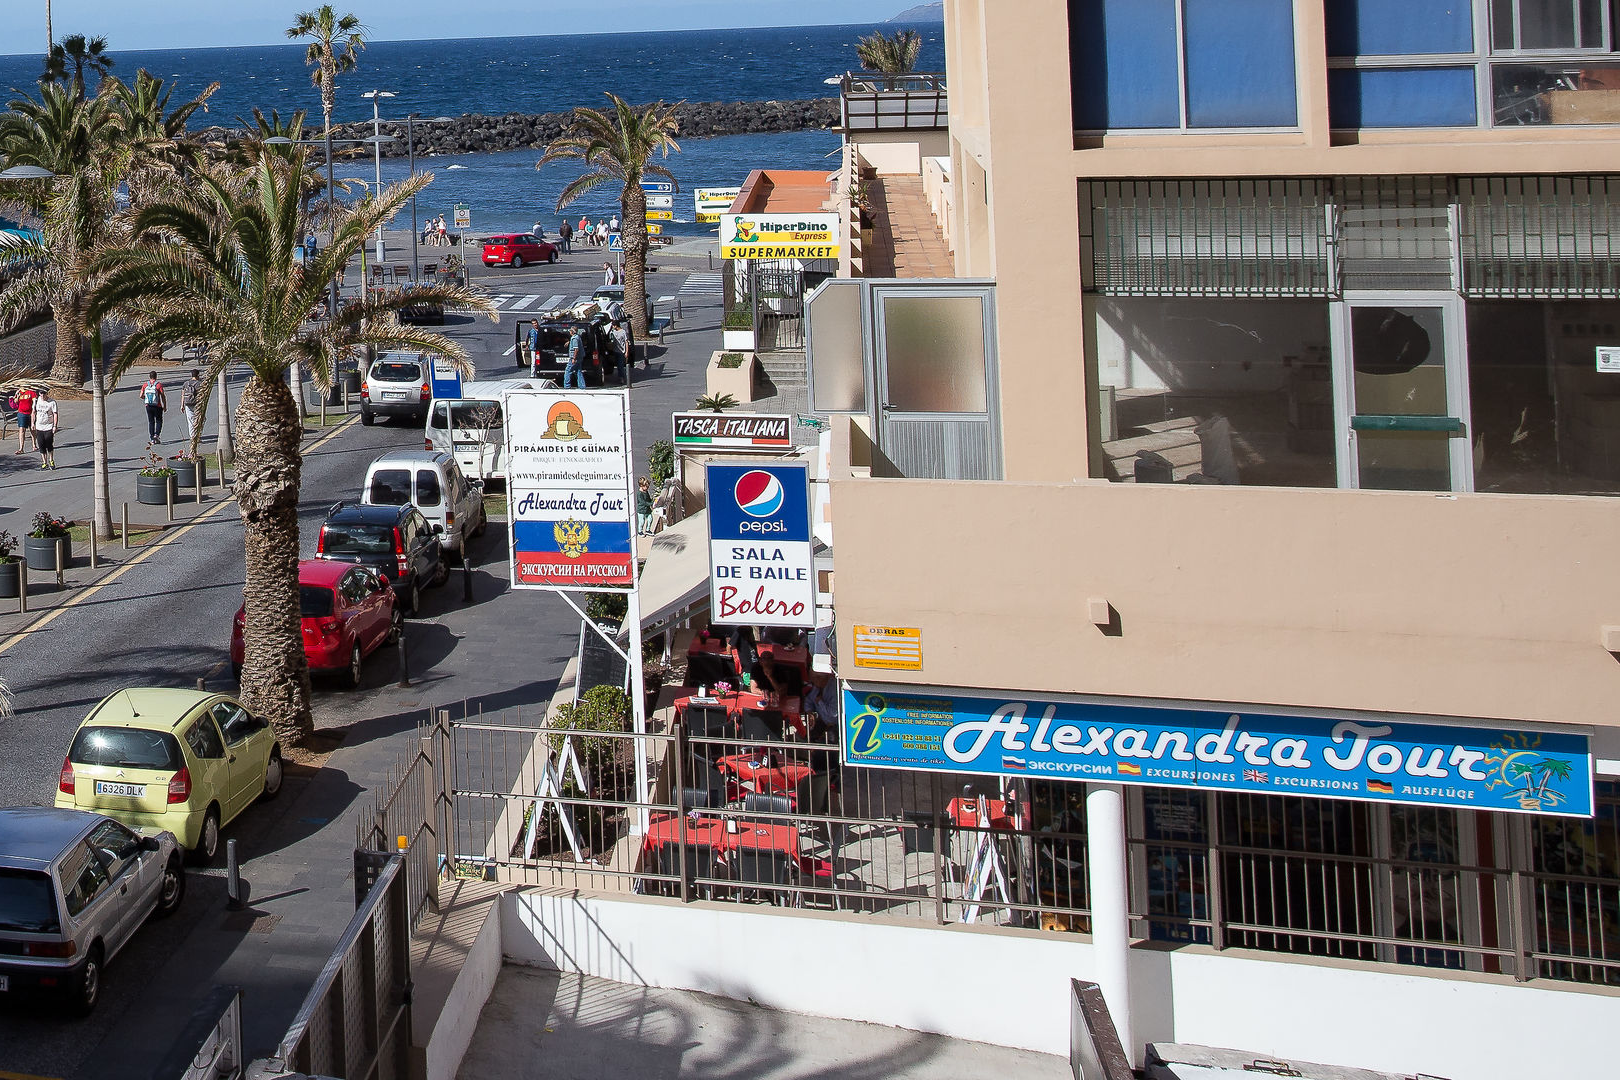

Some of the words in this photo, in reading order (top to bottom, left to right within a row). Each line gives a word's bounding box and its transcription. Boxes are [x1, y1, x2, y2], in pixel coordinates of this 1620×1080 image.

[760, 222, 828, 233] HiperDino
[794, 232, 828, 242] Express
[729, 246, 833, 258] SUPERMARKET
[677, 418, 718, 435] TASCA
[723, 419, 786, 437] ITALIANA
[514, 443, 564, 453] PIRÁMIDES
[567, 445, 579, 453] DE
[581, 443, 620, 453] GÜÍMAR
[516, 471, 622, 482] www.piramidesdeguimar.es
[518, 492, 587, 515] Alexandra
[590, 493, 623, 516] Tour
[739, 520, 784, 534] pepsi
[732, 547, 785, 561] SALA
[521, 563, 572, 576] ЭКСКУРСИИ
[573, 564, 585, 576] НА
[587, 565, 628, 577] РУССКОМ
[716, 565, 742, 579] DE
[749, 566, 807, 581] BAILE
[718, 585, 805, 618] Bolero
[942, 702, 1311, 768] Alexandra
[1323, 720, 1488, 781] Tour
[1028, 760, 1112, 774] ЭКСКУРСИИ
[1146, 768, 1236, 782] EXCURSIONES
[102, 784, 125, 794] 6326
[126, 785, 143, 796] DLK
[1274, 776, 1359, 790] EXCURSIONS
[1401, 784, 1475, 799] AUSFLÜGE
